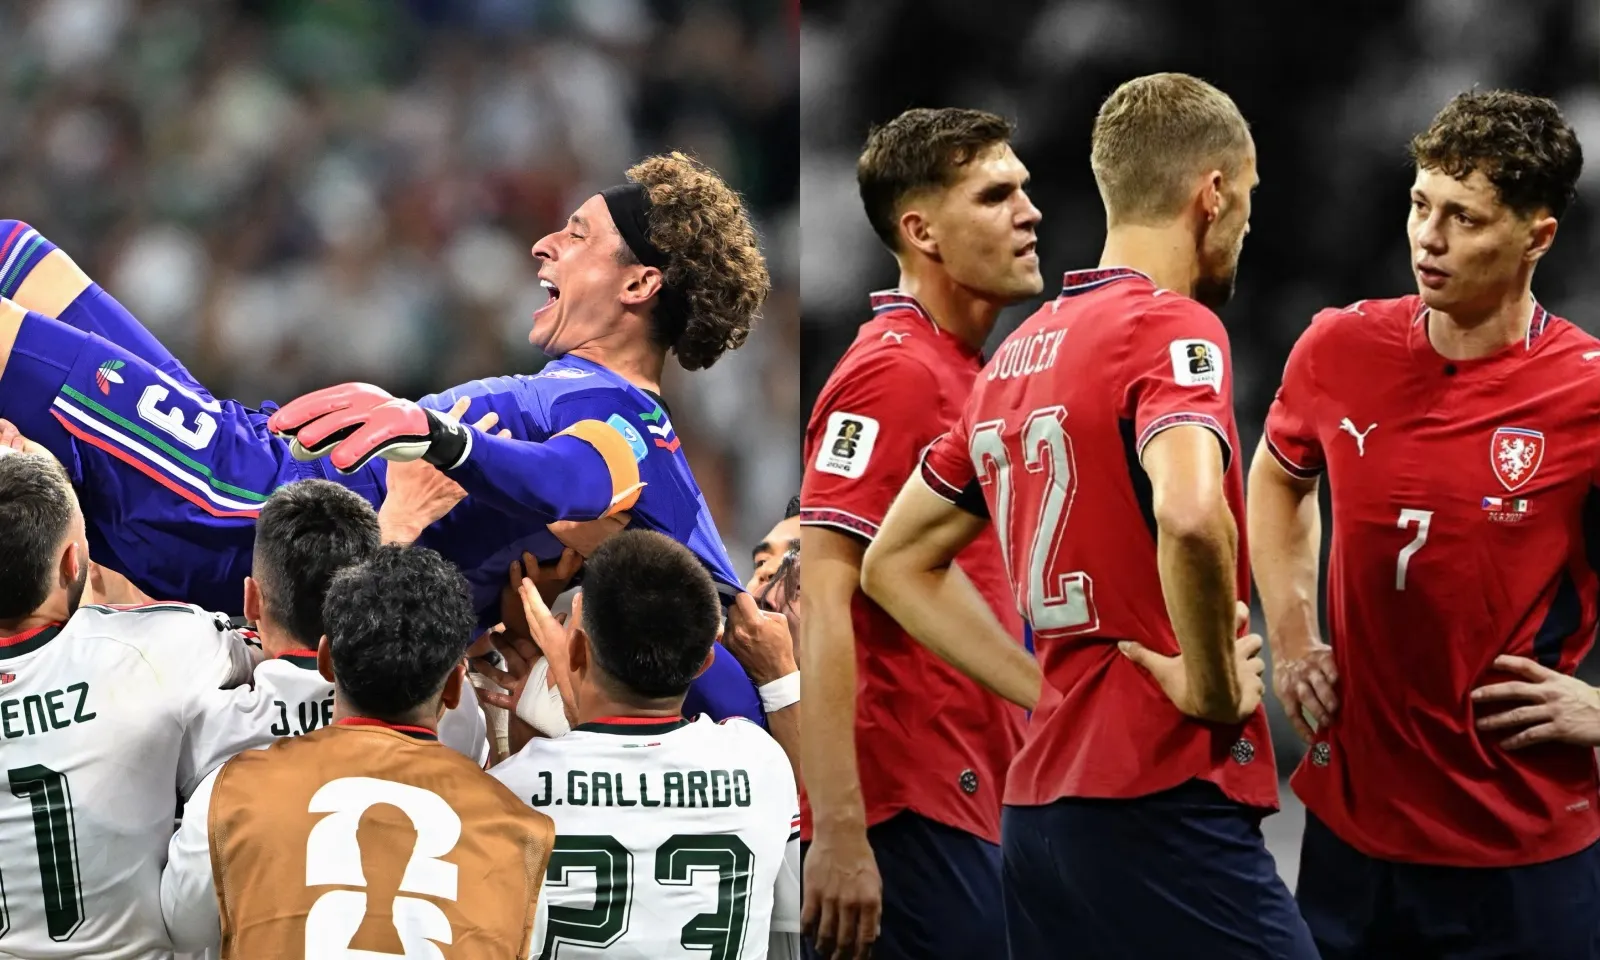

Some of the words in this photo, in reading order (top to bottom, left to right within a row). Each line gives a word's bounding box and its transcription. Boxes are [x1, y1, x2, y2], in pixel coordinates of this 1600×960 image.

[1396, 508, 1435, 591] 7
[0, 681, 97, 740] ENEZ
[531, 769, 752, 808] J.GALLARDO
[0, 763, 86, 942] 1
[539, 834, 755, 960] 23
